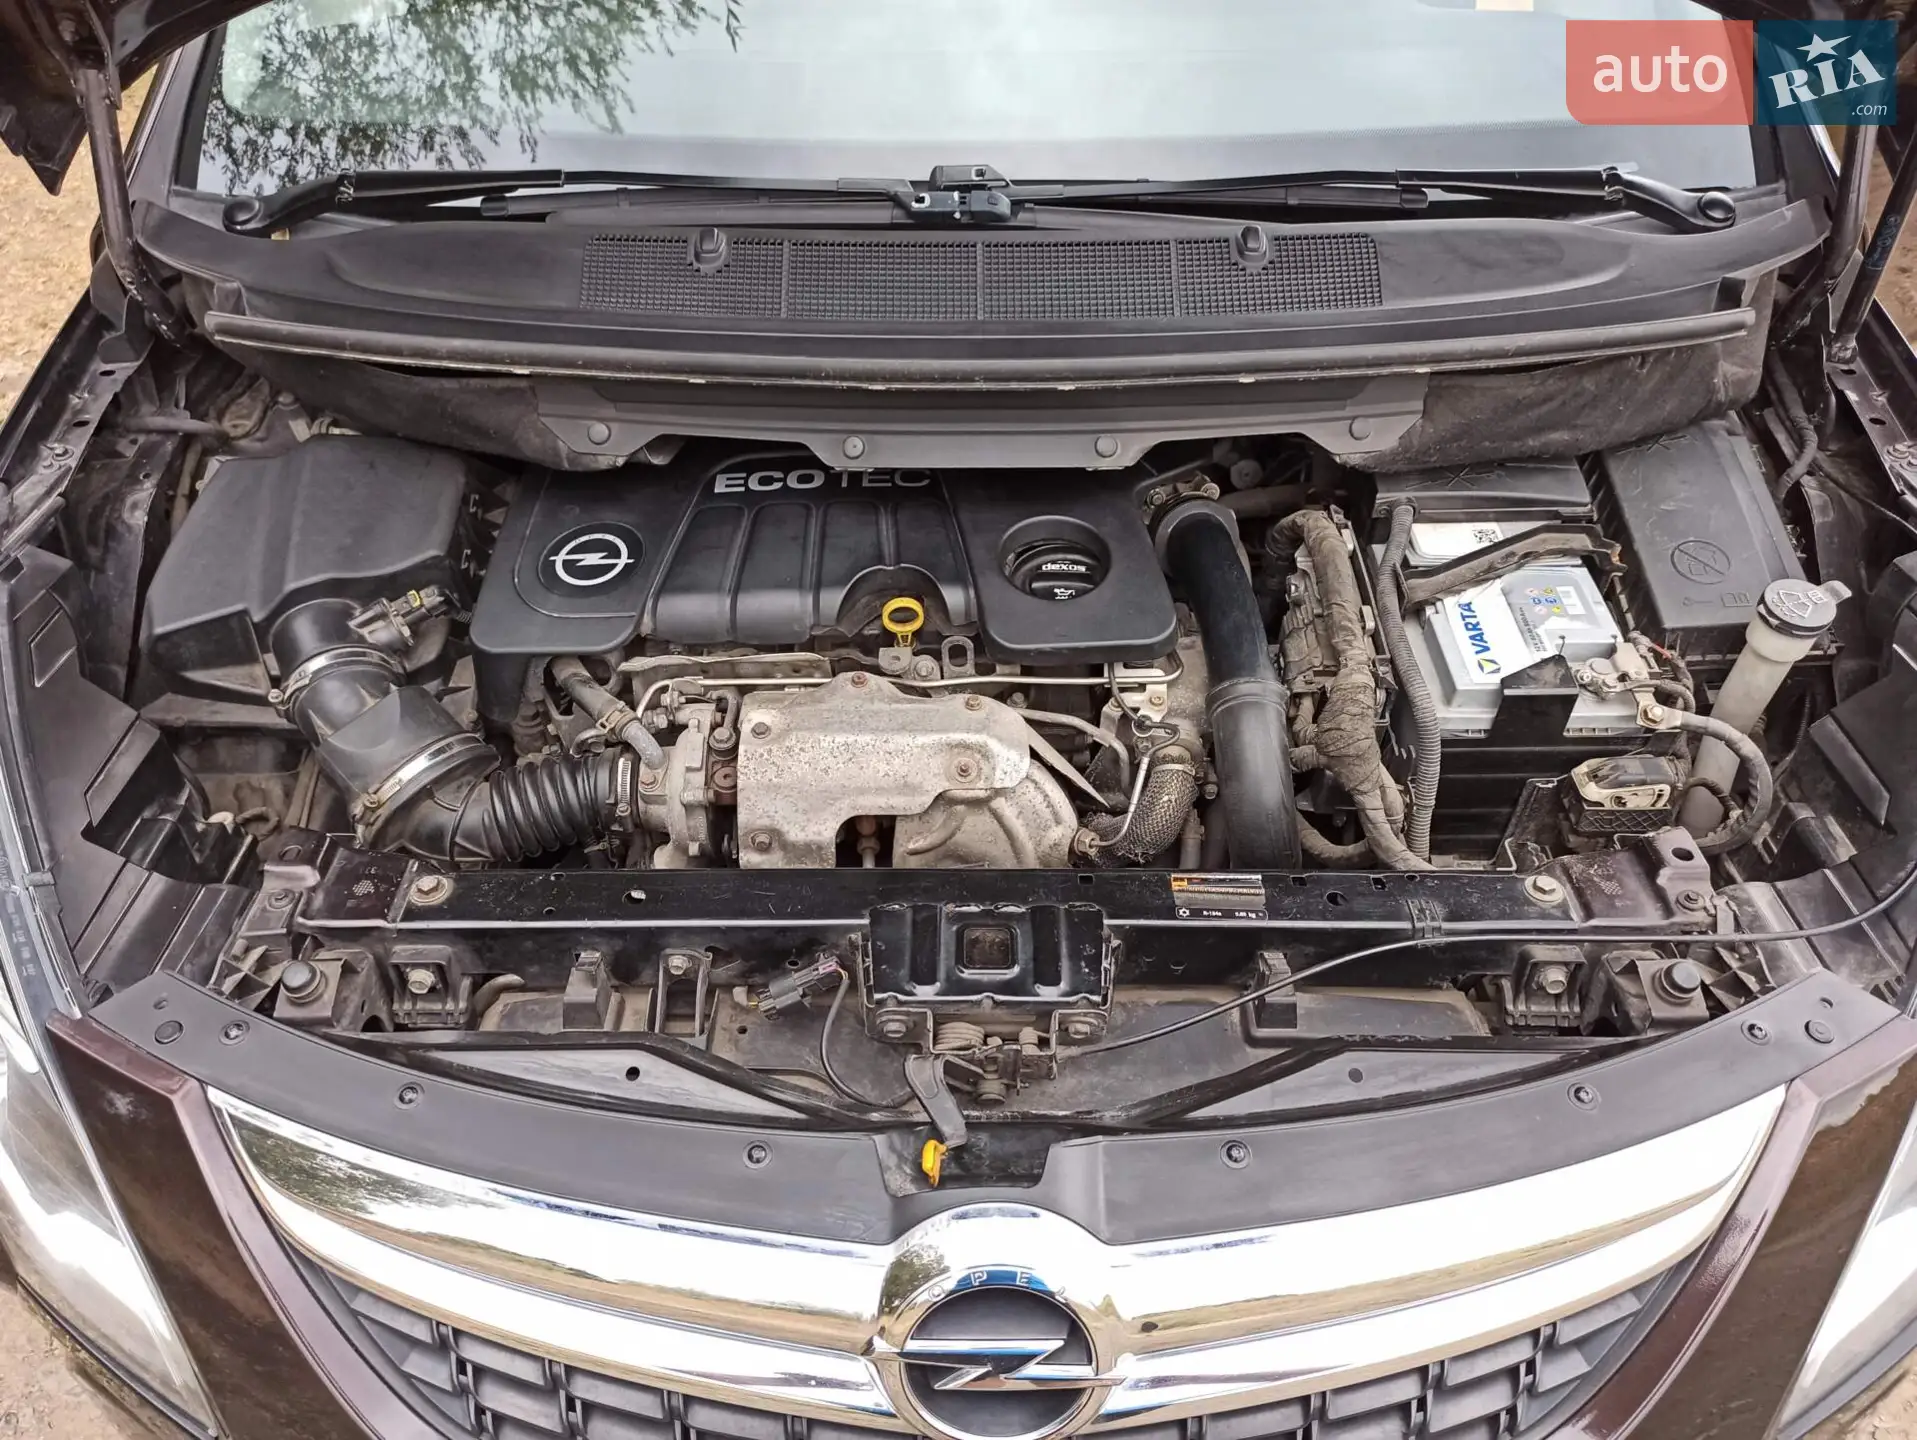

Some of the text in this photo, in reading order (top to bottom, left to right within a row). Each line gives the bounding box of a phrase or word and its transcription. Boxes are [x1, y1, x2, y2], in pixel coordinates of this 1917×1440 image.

[714, 468, 931, 493] ECOTEC
[1042, 562, 1087, 572] dexos
[1458, 602, 1491, 655] VARTA
[928, 1270, 1066, 1304] OPEL
